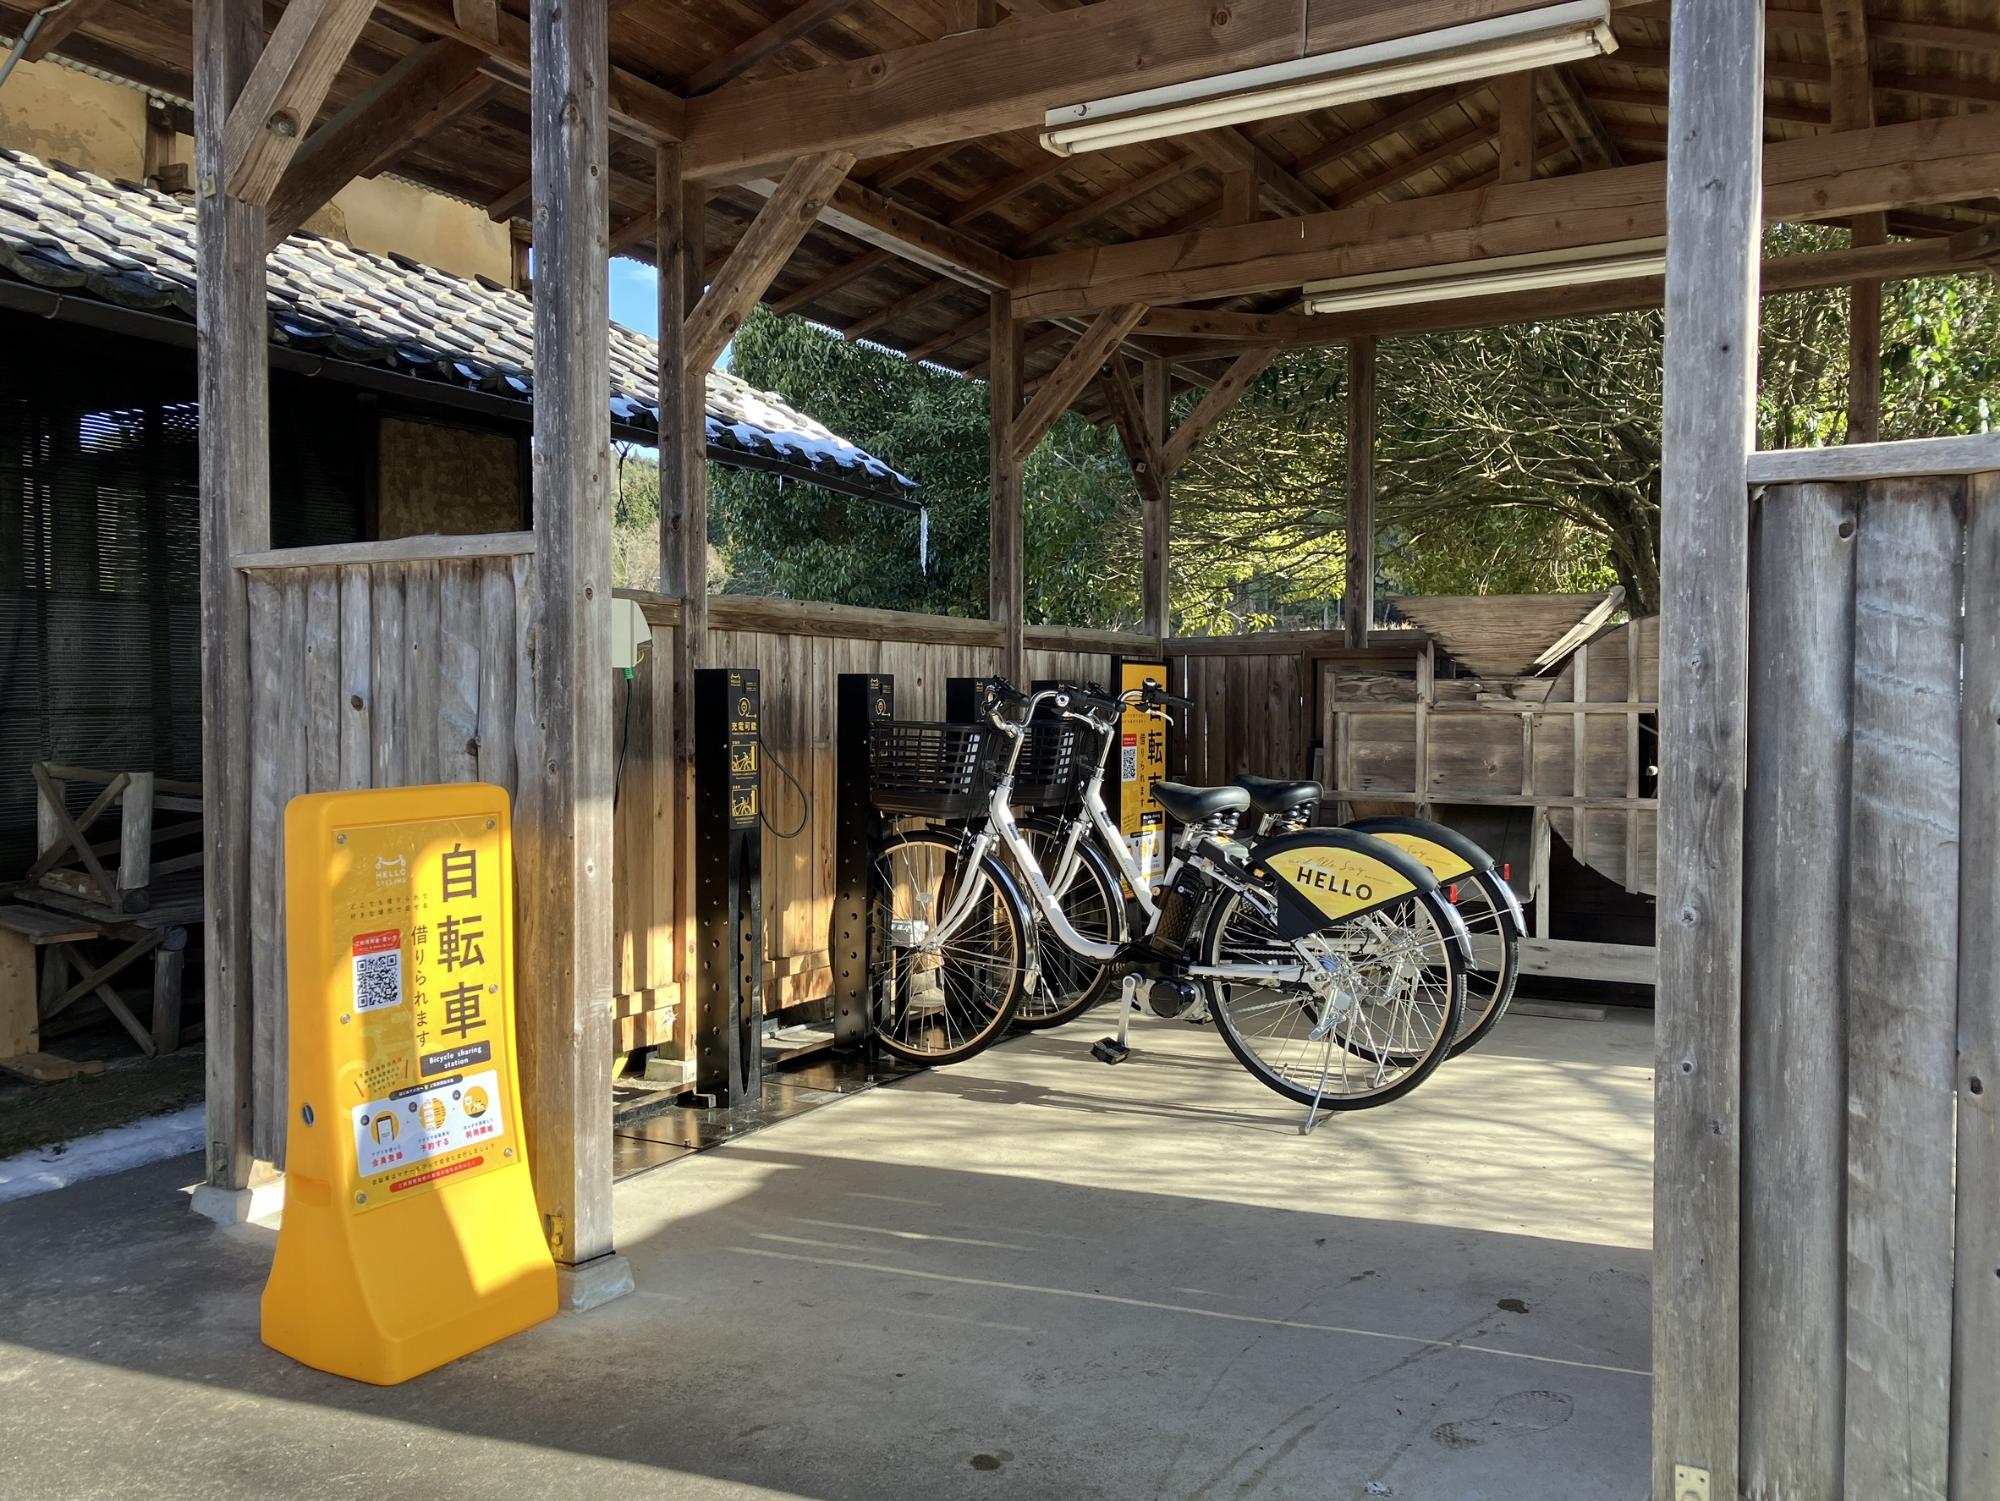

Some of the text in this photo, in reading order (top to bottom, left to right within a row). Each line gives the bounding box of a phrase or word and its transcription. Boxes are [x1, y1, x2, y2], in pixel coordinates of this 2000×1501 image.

[1296, 866, 1373, 901] HELLO
[437, 843, 487, 1039] 自転車
[411, 925, 430, 1047] 借りられます
[429, 1046, 482, 1065] Bicycle sharing
[444, 1057, 469, 1069] station
